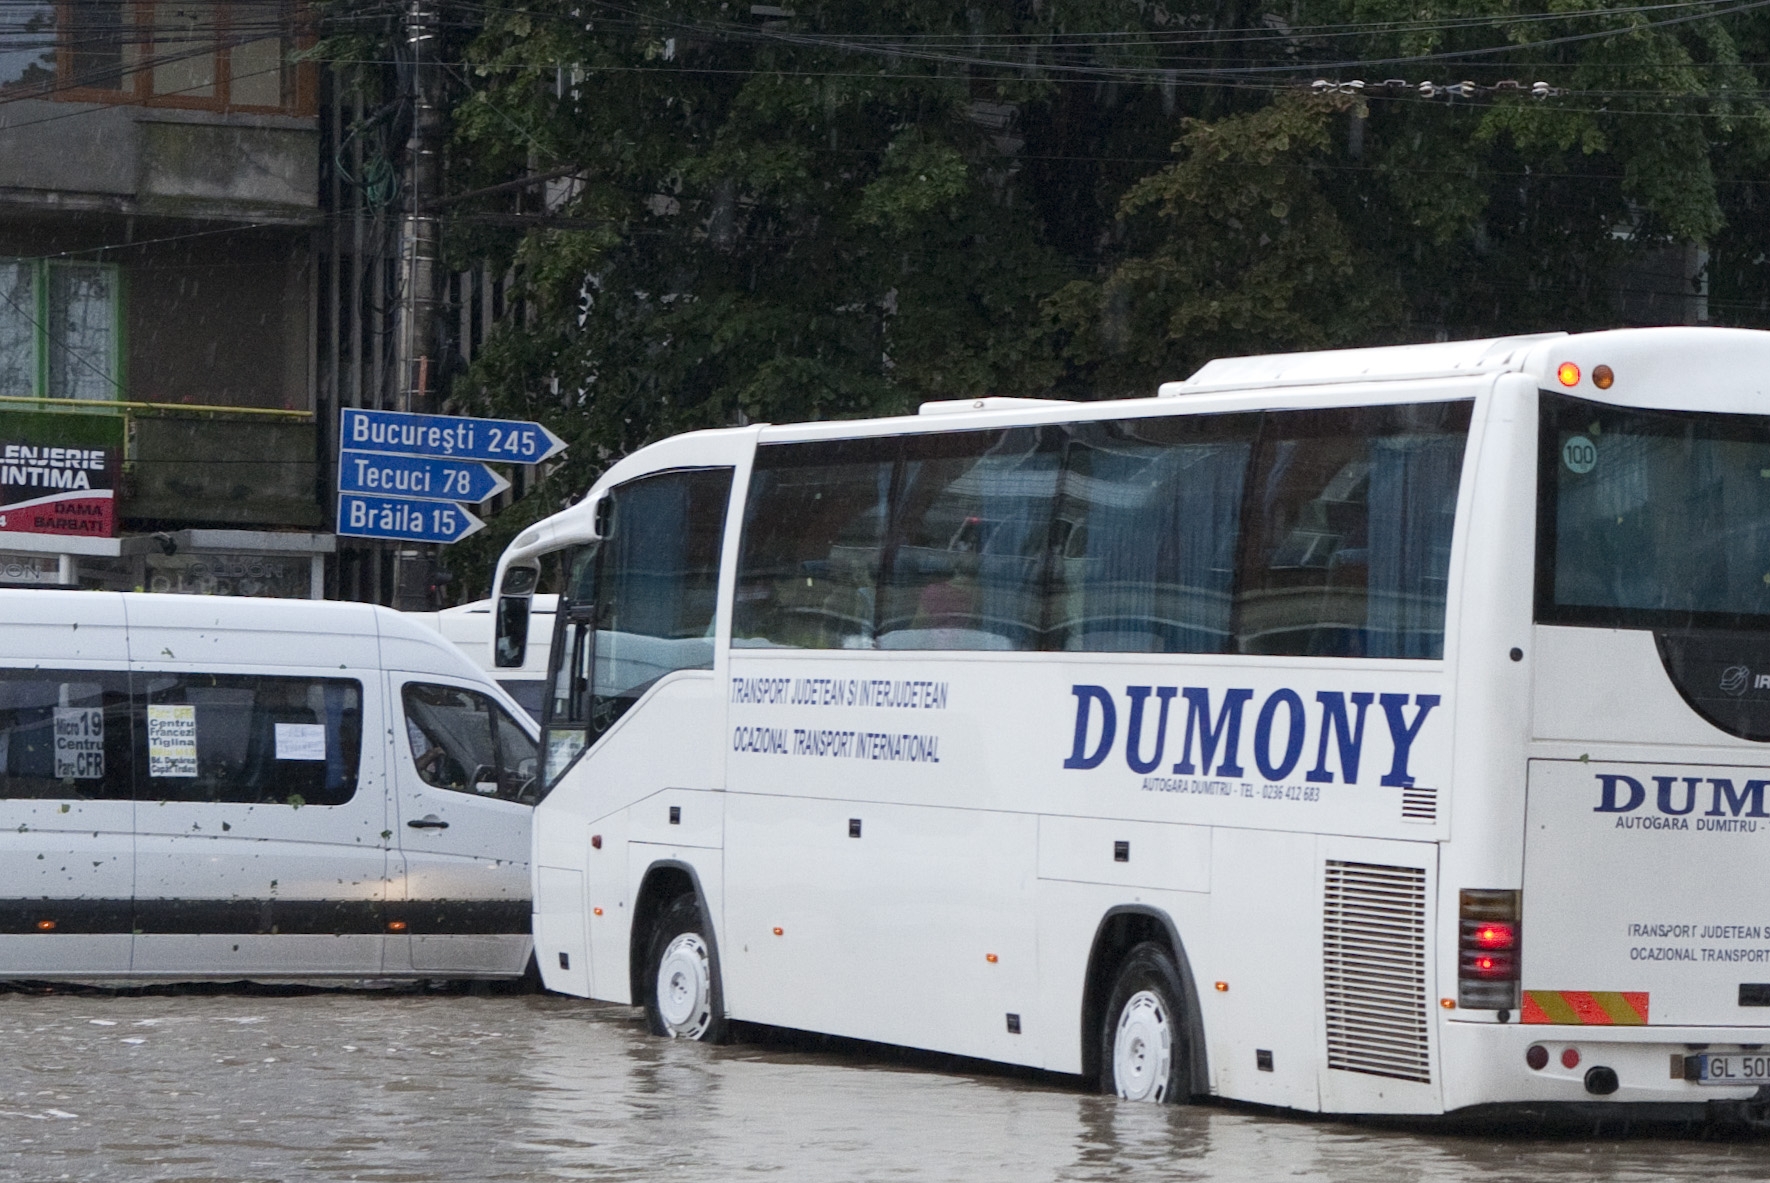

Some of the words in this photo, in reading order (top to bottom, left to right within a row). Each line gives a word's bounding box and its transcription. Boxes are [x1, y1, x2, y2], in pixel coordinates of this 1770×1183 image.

[488, 428, 536, 456] 245
[1566, 445, 1594, 464] 100
[0, 444, 106, 471] ENJERIE
[1, 465, 91, 490] INTIMA
[354, 459, 431, 492] Tecuci
[443, 469, 471, 494] 78
[350, 500, 423, 533] Brăila
[432, 509, 456, 535] 15
[731, 678, 791, 704] TRANSPORT
[791, 679, 846, 706] JUDETEAN
[859, 680, 949, 709] INTERJUDETEAN
[56, 717, 80, 736] Micro
[80, 711, 102, 736] 19
[149, 719, 195, 728] Centru
[150, 727, 195, 737] Francezi
[1063, 684, 1442, 787] DUMONY
[56, 737, 104, 750] Centru
[733, 726, 788, 755] OCAZIONAL
[793, 729, 855, 758] TRANSPORT
[855, 732, 940, 763] INTERNATIONAL
[76, 751, 104, 776] CFR
[1141, 777, 1189, 794] AUTOGARA
[1190, 780, 1233, 796] DUMITRU
[1240, 783, 1254, 798] TEL
[1262, 785, 1284, 799] 0236
[1285, 786, 1301, 801] 412
[1303, 787, 1321, 802] 683
[1615, 815, 1689, 831] AUTOGARA
[1696, 818, 1757, 833] DUMITRU
[1628, 923, 1698, 938] TRANSPORT
[1700, 925, 1761, 939] JUDETEAN
[1630, 947, 1698, 962] OCAZIONAL
[1711, 1057, 1736, 1078] GL
